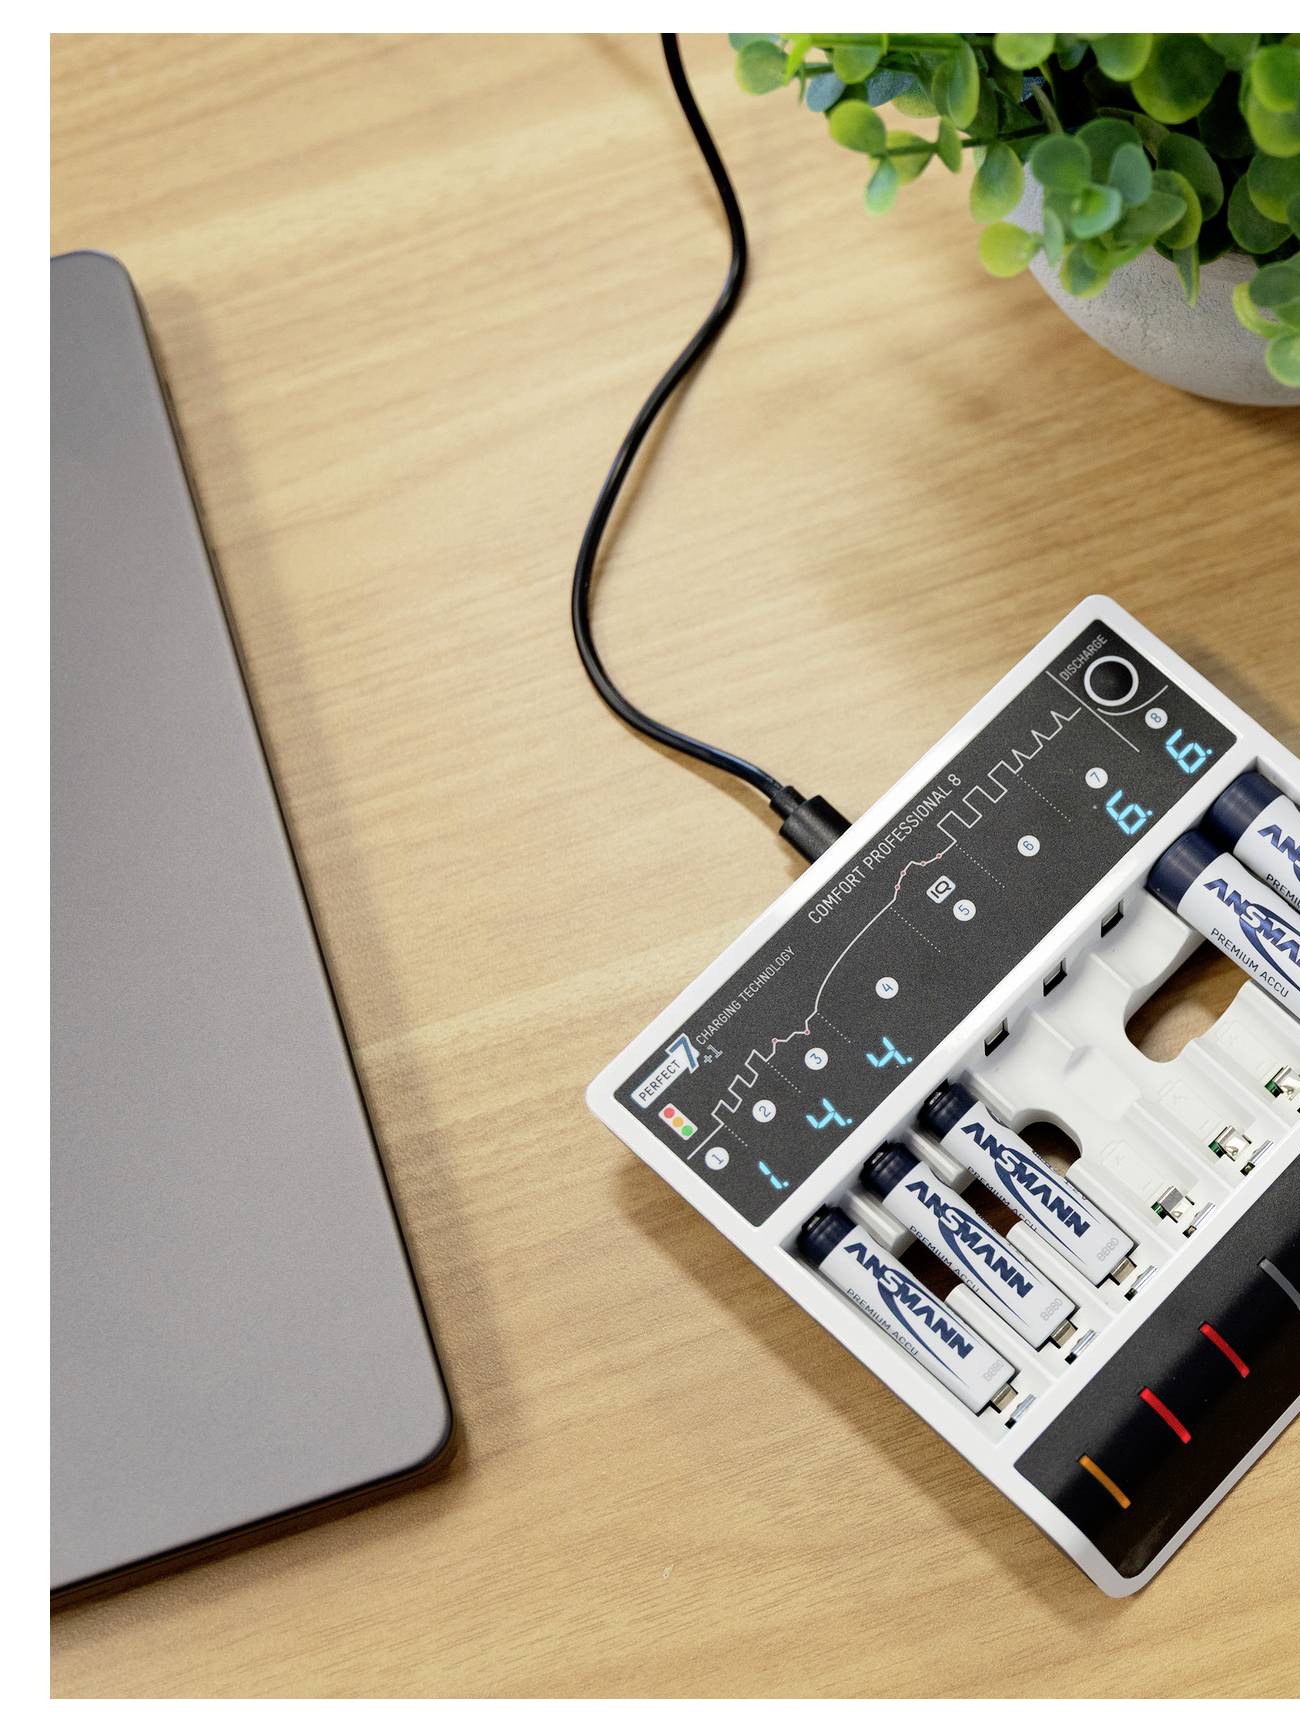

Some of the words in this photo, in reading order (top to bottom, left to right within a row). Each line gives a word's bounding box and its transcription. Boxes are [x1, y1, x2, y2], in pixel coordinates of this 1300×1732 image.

[1058, 634, 1108, 682] DISCHARGE
[808, 865, 866, 924] COMFORT
[862, 786, 952, 870] PROFESSIONAL
[947, 773, 962, 786] 8
[930, 880, 952, 899] IQ
[1211, 928, 1258, 972] PREMIUM
[1259, 970, 1289, 999] ACCU
[638, 1059, 681, 1102] PERFECT
[666, 1033, 699, 1073] 7
[695, 998, 742, 1045] CHARGING
[738, 946, 796, 1002] TECHNOLOGY
[703, 1044, 724, 1064] +1
[961, 1122, 1091, 1238] ANSMANN
[905, 1180, 1033, 1298] ANSMANN
[910, 1225, 953, 1267] PREMIUM
[844, 1242, 974, 1359] ANSMANN
[846, 1288, 891, 1330] PREMIUM
[891, 1330, 919, 1356] ACCU
